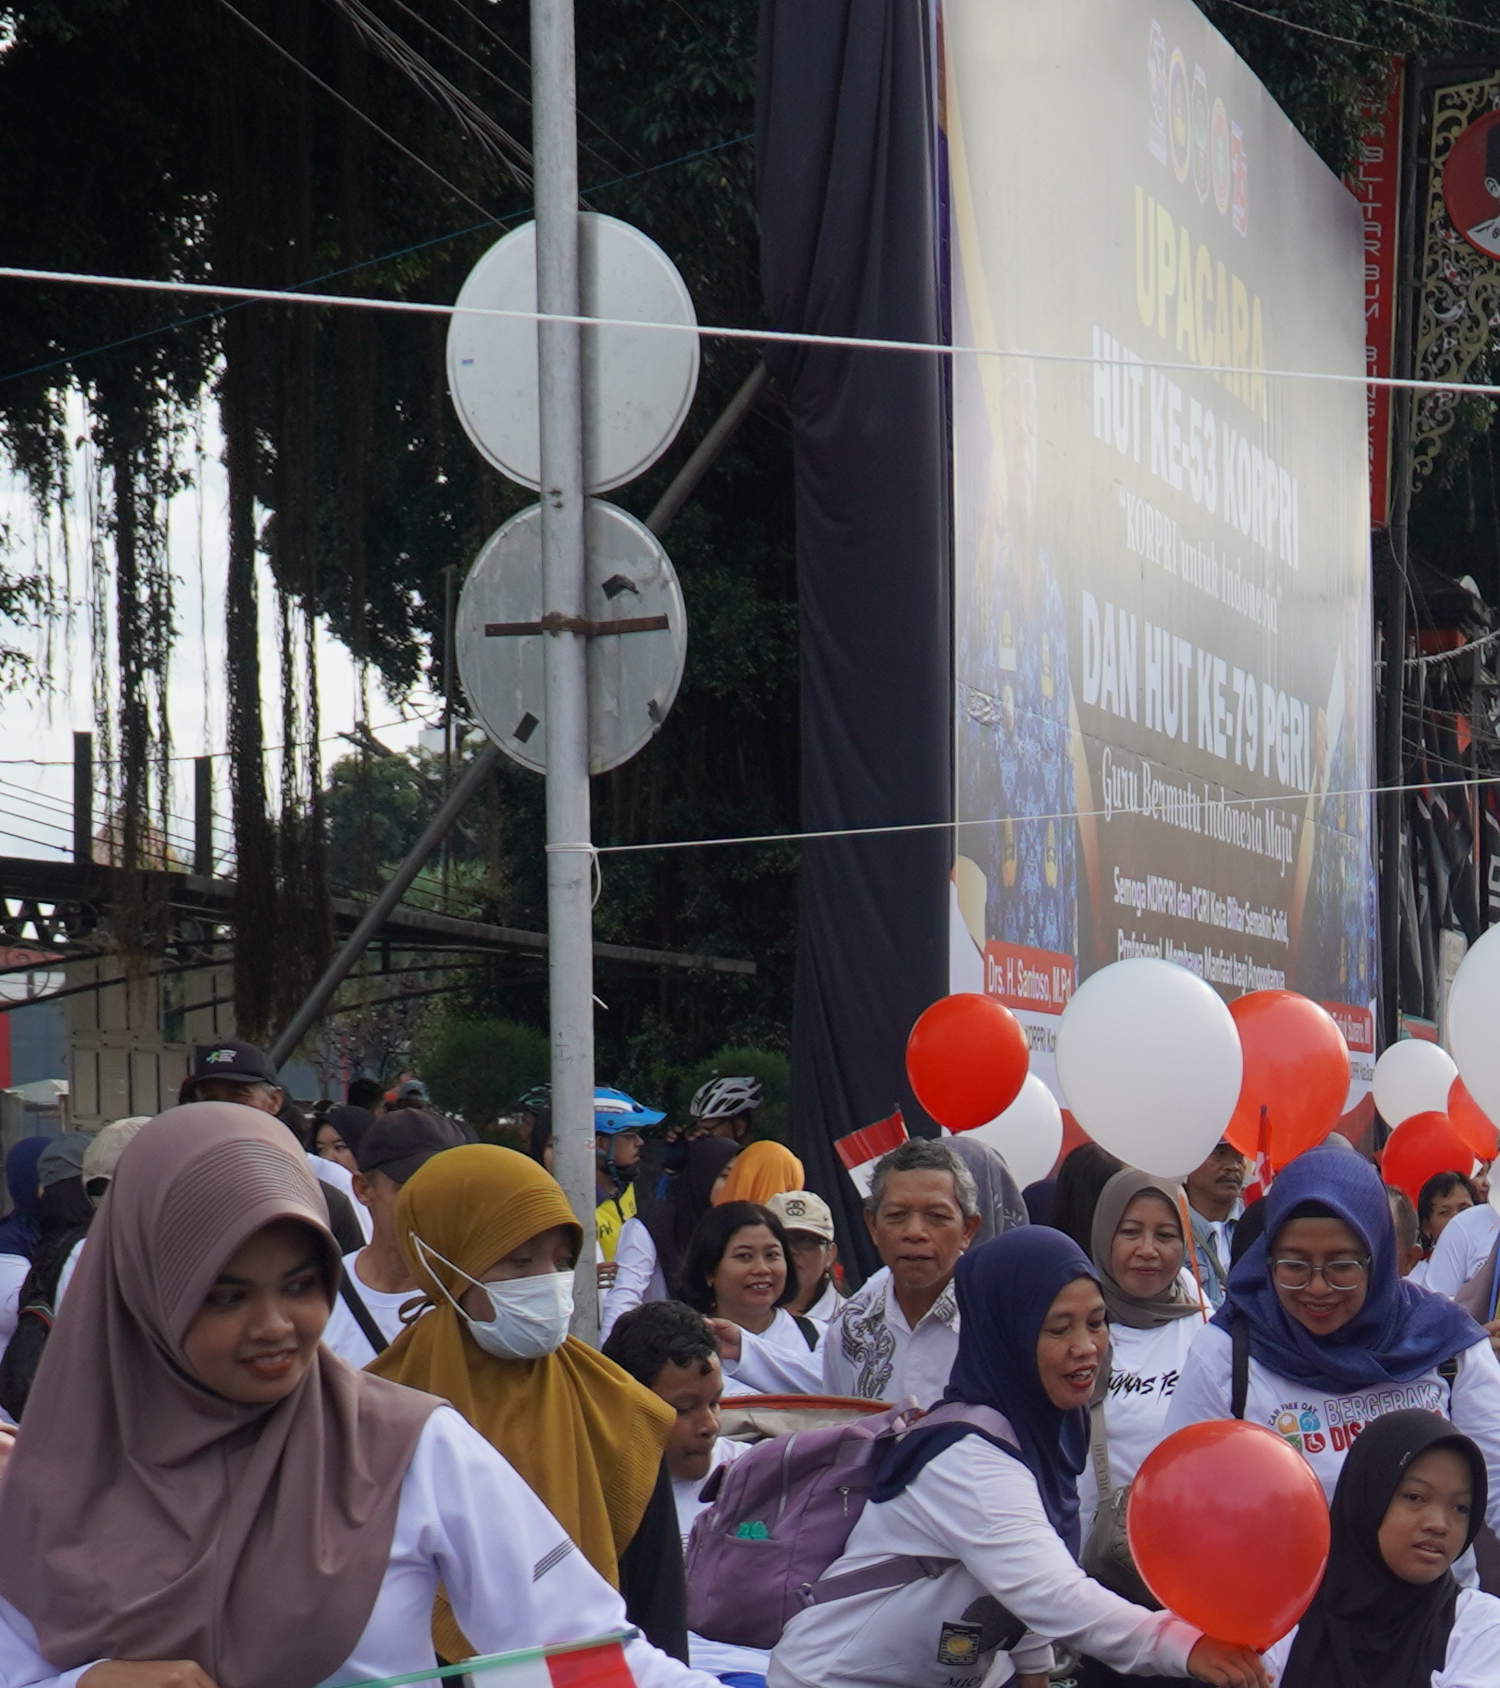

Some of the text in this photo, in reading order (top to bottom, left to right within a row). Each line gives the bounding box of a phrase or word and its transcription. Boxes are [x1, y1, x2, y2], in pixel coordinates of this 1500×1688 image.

[1134, 183, 1268, 424] UPACARA
[1092, 323, 1144, 465] HUT
[1150, 366, 1218, 515] KE-53
[1223, 422, 1299, 571] KORPRI
[1083, 590, 1310, 793] DAN HUT KE-79 PGRI
[1142, 761, 1201, 834] Bermutu
[1204, 784, 1263, 854] Indonesia
